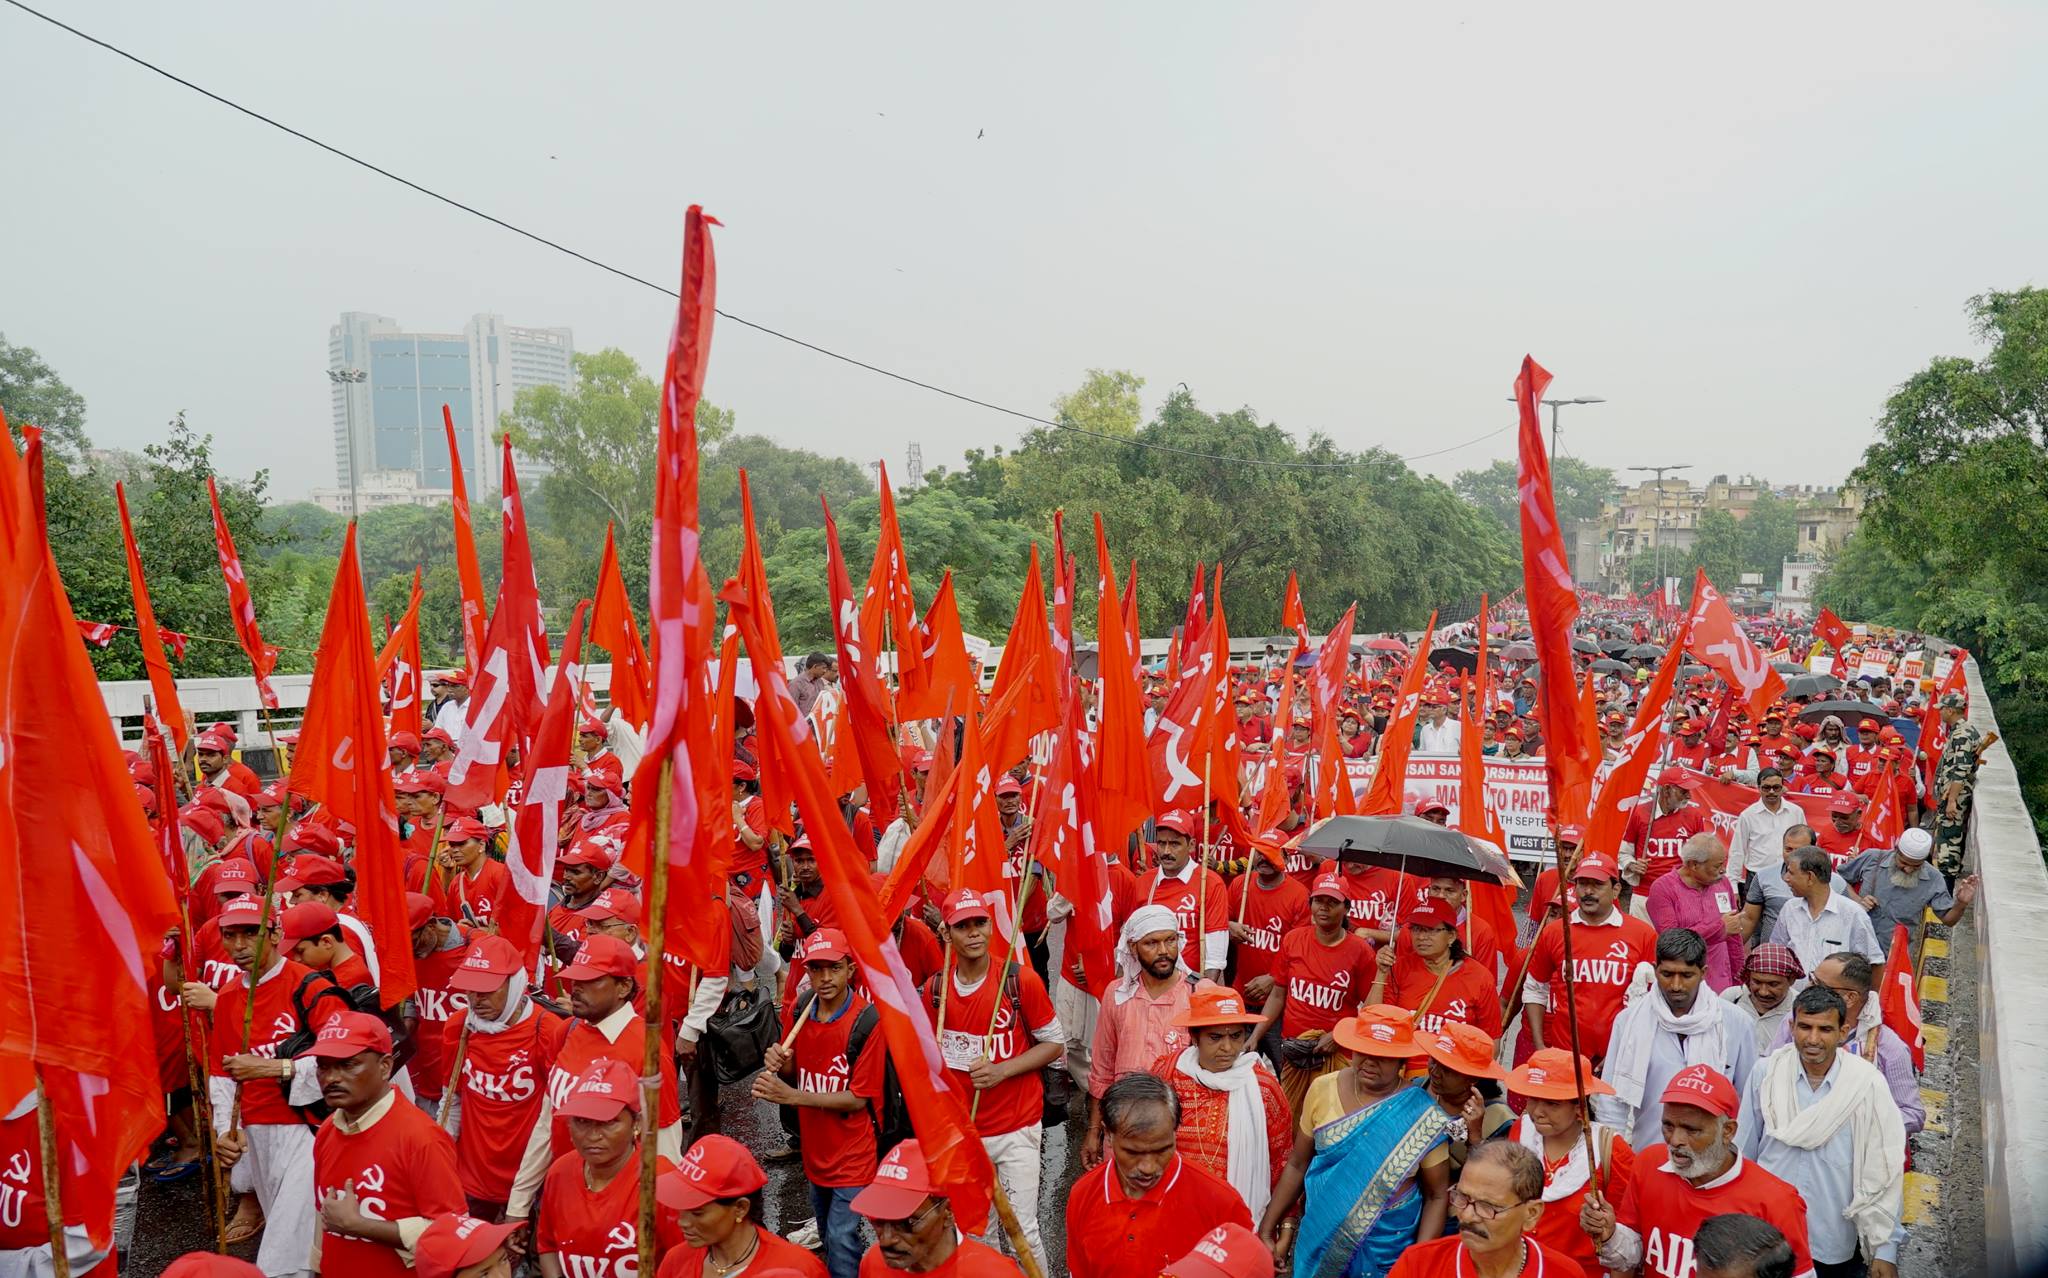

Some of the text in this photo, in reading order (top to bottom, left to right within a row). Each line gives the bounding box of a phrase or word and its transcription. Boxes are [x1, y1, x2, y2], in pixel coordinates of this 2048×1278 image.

[1849, 655, 1860, 665] CI
[1866, 651, 1889, 662] CITU
[1905, 664, 1922, 676] CITU
[1406, 764, 1435, 776] ISAN
[1520, 769, 1548, 782] RALL
[1492, 790, 1507, 811] TO
[1515, 817, 1547, 828] SEPTE
[1513, 838, 1538, 849] WEST
[221, 870, 246, 879] CITU
[1290, 977, 1347, 1012] AIAWU
[1677, 1078, 1713, 1094] CITU
